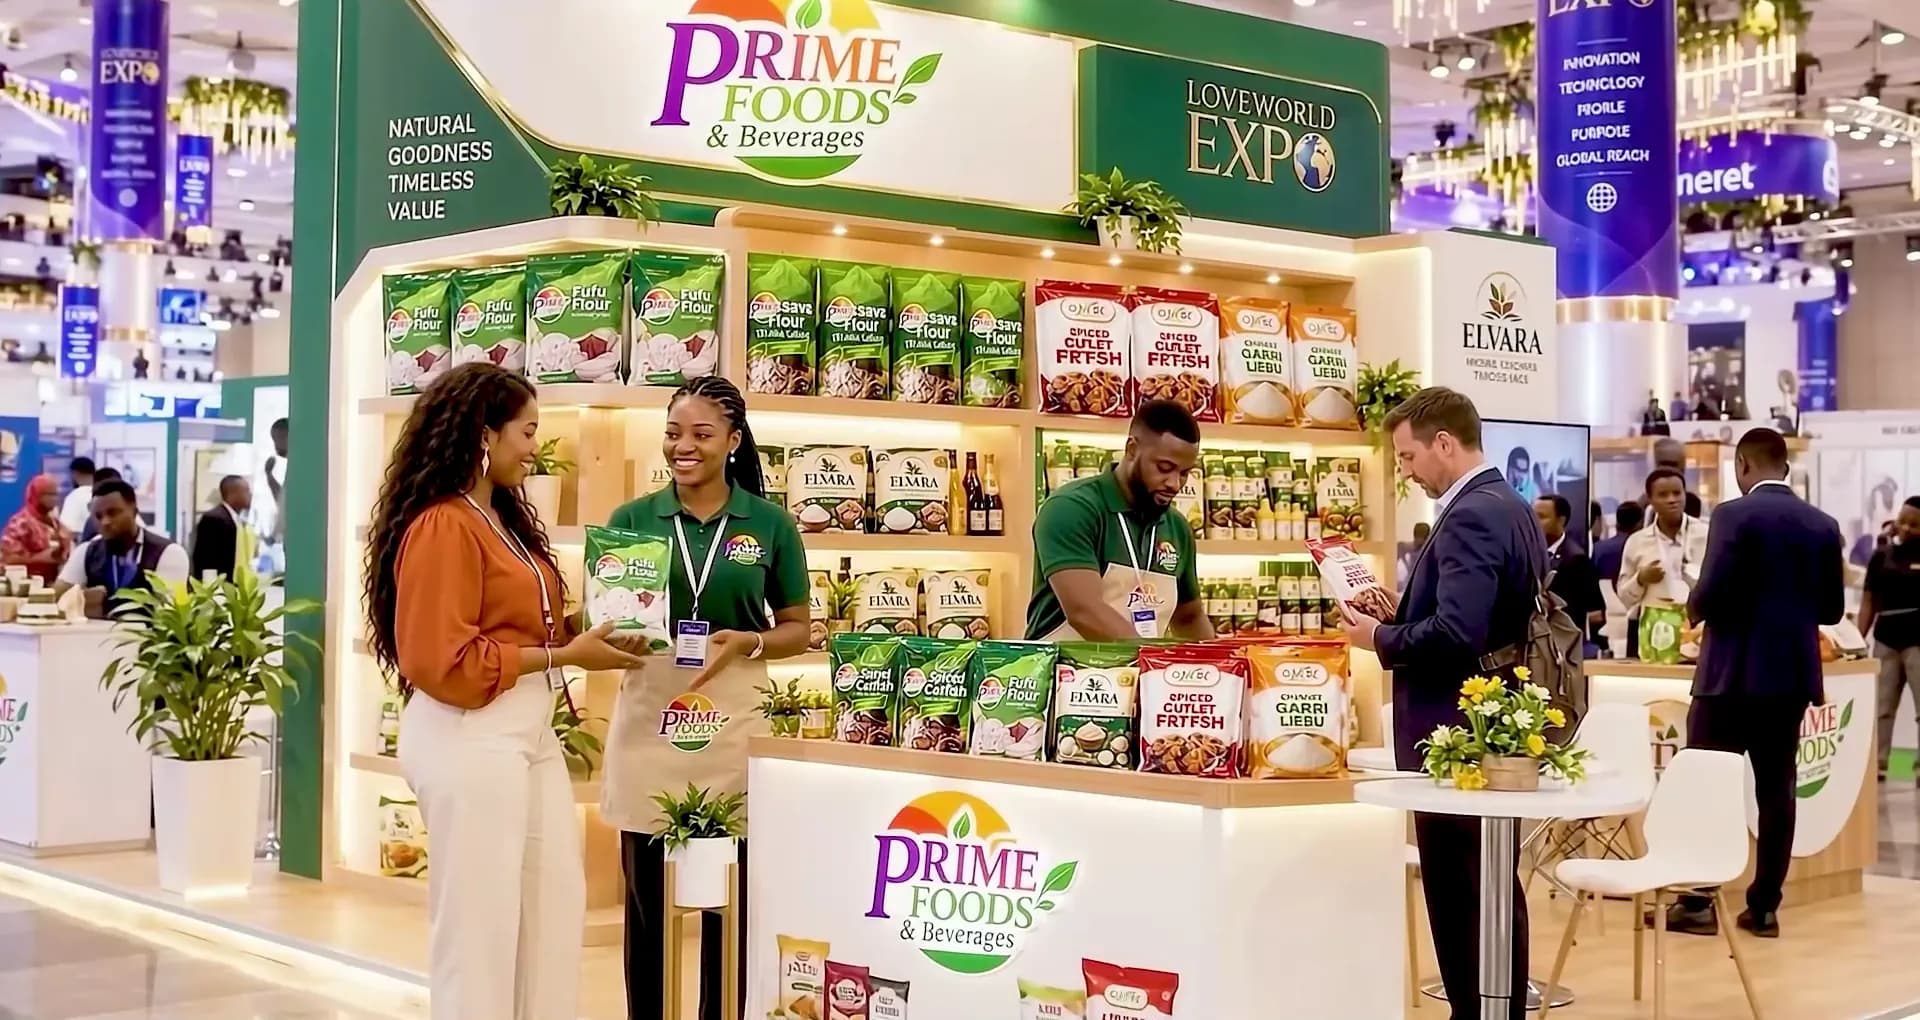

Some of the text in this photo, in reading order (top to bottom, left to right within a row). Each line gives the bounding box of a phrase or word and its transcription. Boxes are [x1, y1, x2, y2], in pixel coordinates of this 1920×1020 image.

[650, 22, 900, 126] PRIME
[719, 85, 891, 124] FOODS
[1187, 79, 1335, 130] LOVEWORLD
[388, 113, 476, 138] NATURAL
[706, 124, 864, 154] & Beverages
[388, 141, 493, 166] GOODNESS
[388, 170, 474, 193] TIMELESS
[387, 200, 445, 220] VALUE
[1462, 322, 1544, 355] ELVARA
[1007, 687, 1040, 701] Flour
[1009, 676, 1037, 689] Fufu
[1276, 703, 1328, 714] GARRI
[864, 834, 1039, 919] PRIME
[909, 885, 1034, 929] FOODS
[900, 919, 1015, 952] & Beverages
